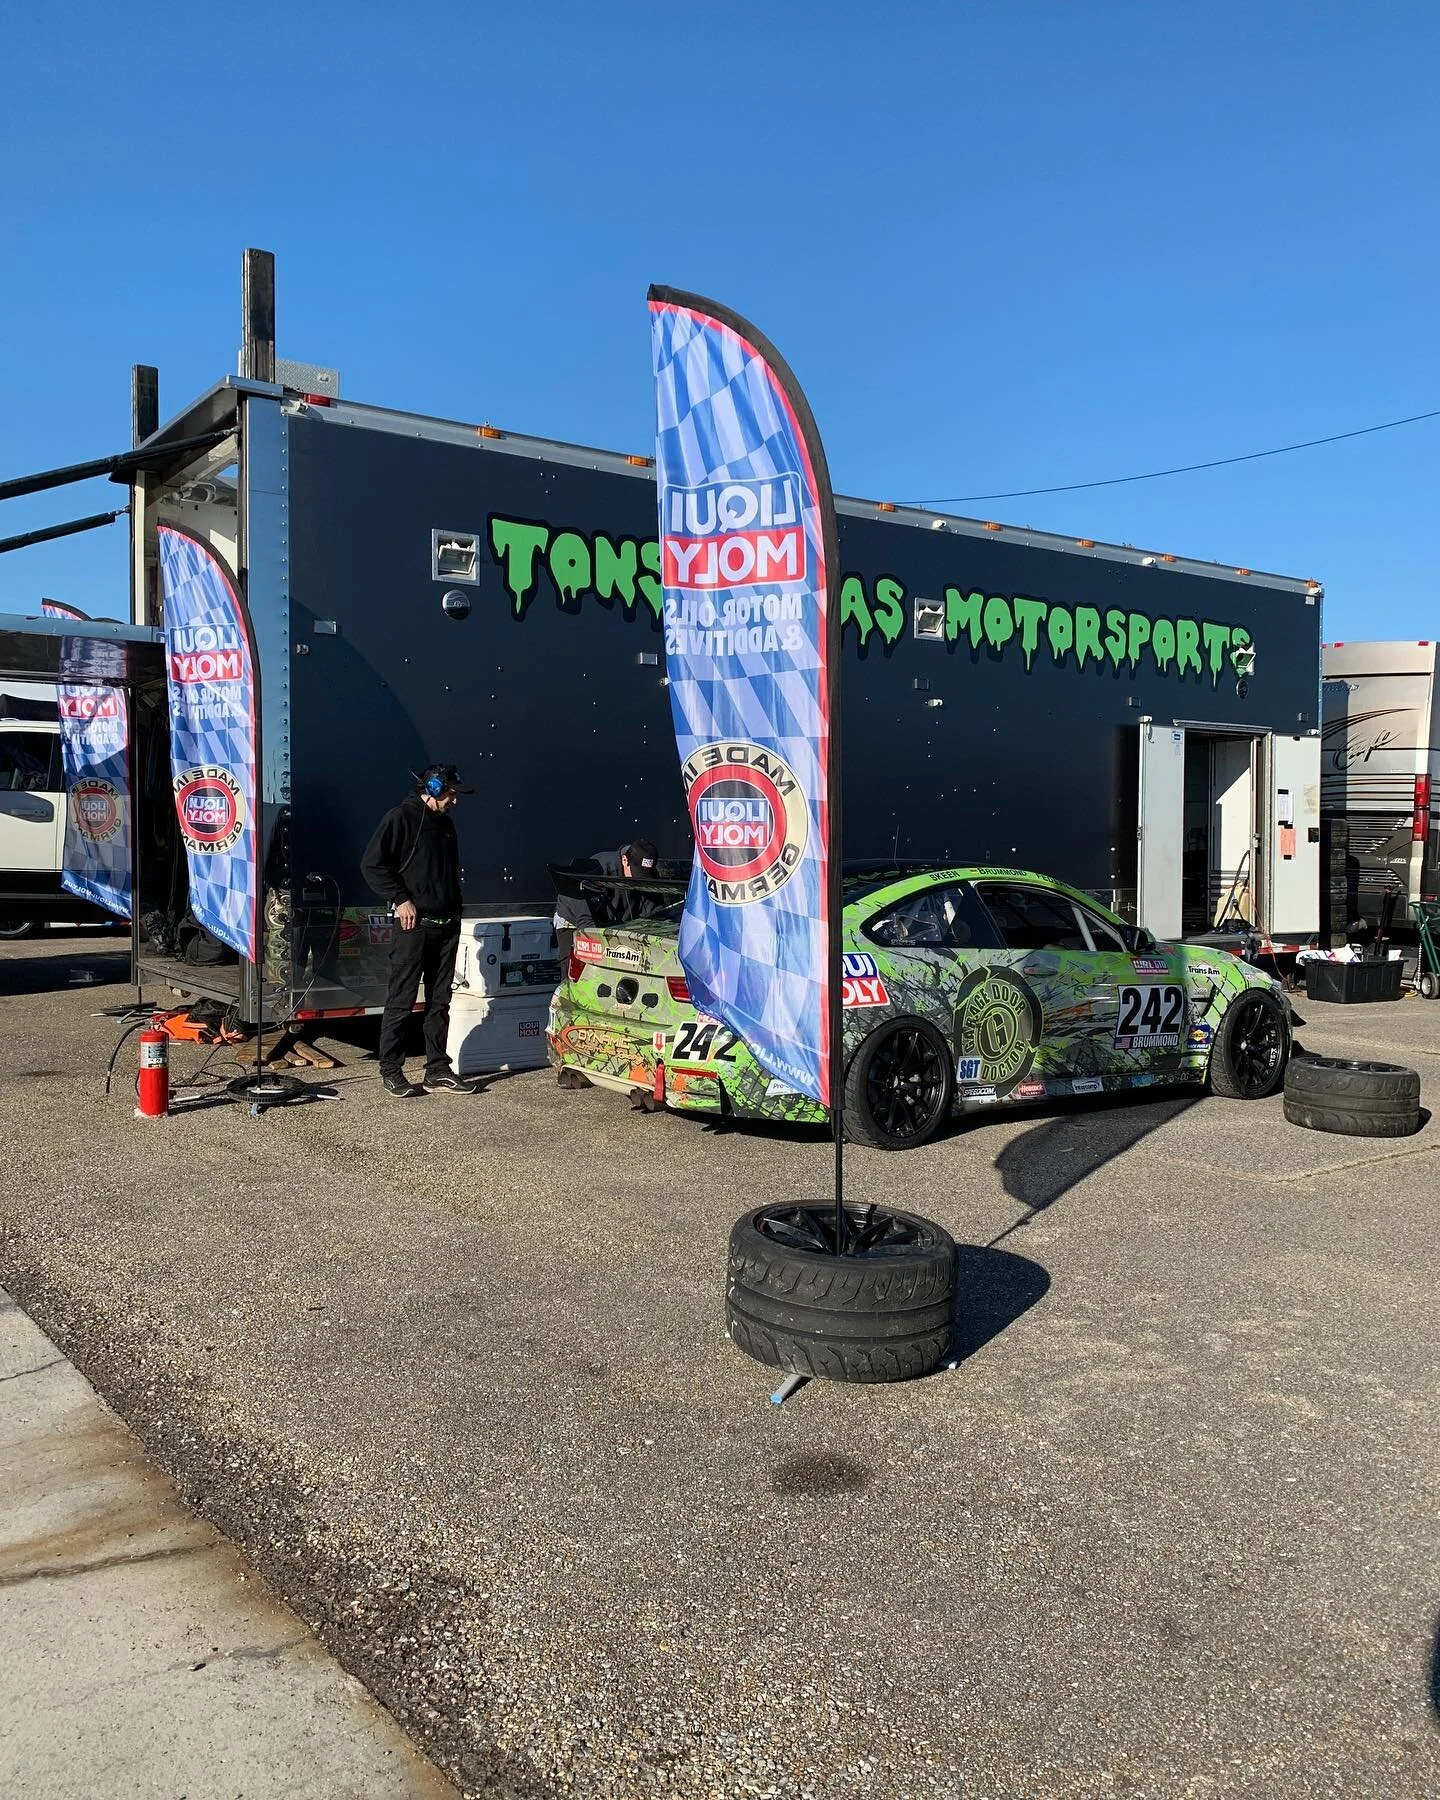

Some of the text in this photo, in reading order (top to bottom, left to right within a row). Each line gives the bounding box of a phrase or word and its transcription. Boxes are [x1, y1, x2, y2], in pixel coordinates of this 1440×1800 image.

[945, 588, 1252, 689] MOTORSPORTS
[929, 871, 960, 881] SKEEN
[605, 948, 625, 959] Trans
[625, 951, 640, 962] Am
[1188, 966, 1220, 975] Trans Am
[964, 983, 1027, 1053] GARAGE DOOR
[1118, 986, 1183, 1036] 242
[519, 1021, 539, 1030] LIQUI
[519, 1029, 539, 1037] MOLY
[672, 1023, 738, 1062] 242
[1132, 1035, 1179, 1048] BRUMMOND
[960, 1059, 981, 1079] SGT
[982, 1040, 1026, 1081] DOCTOR
